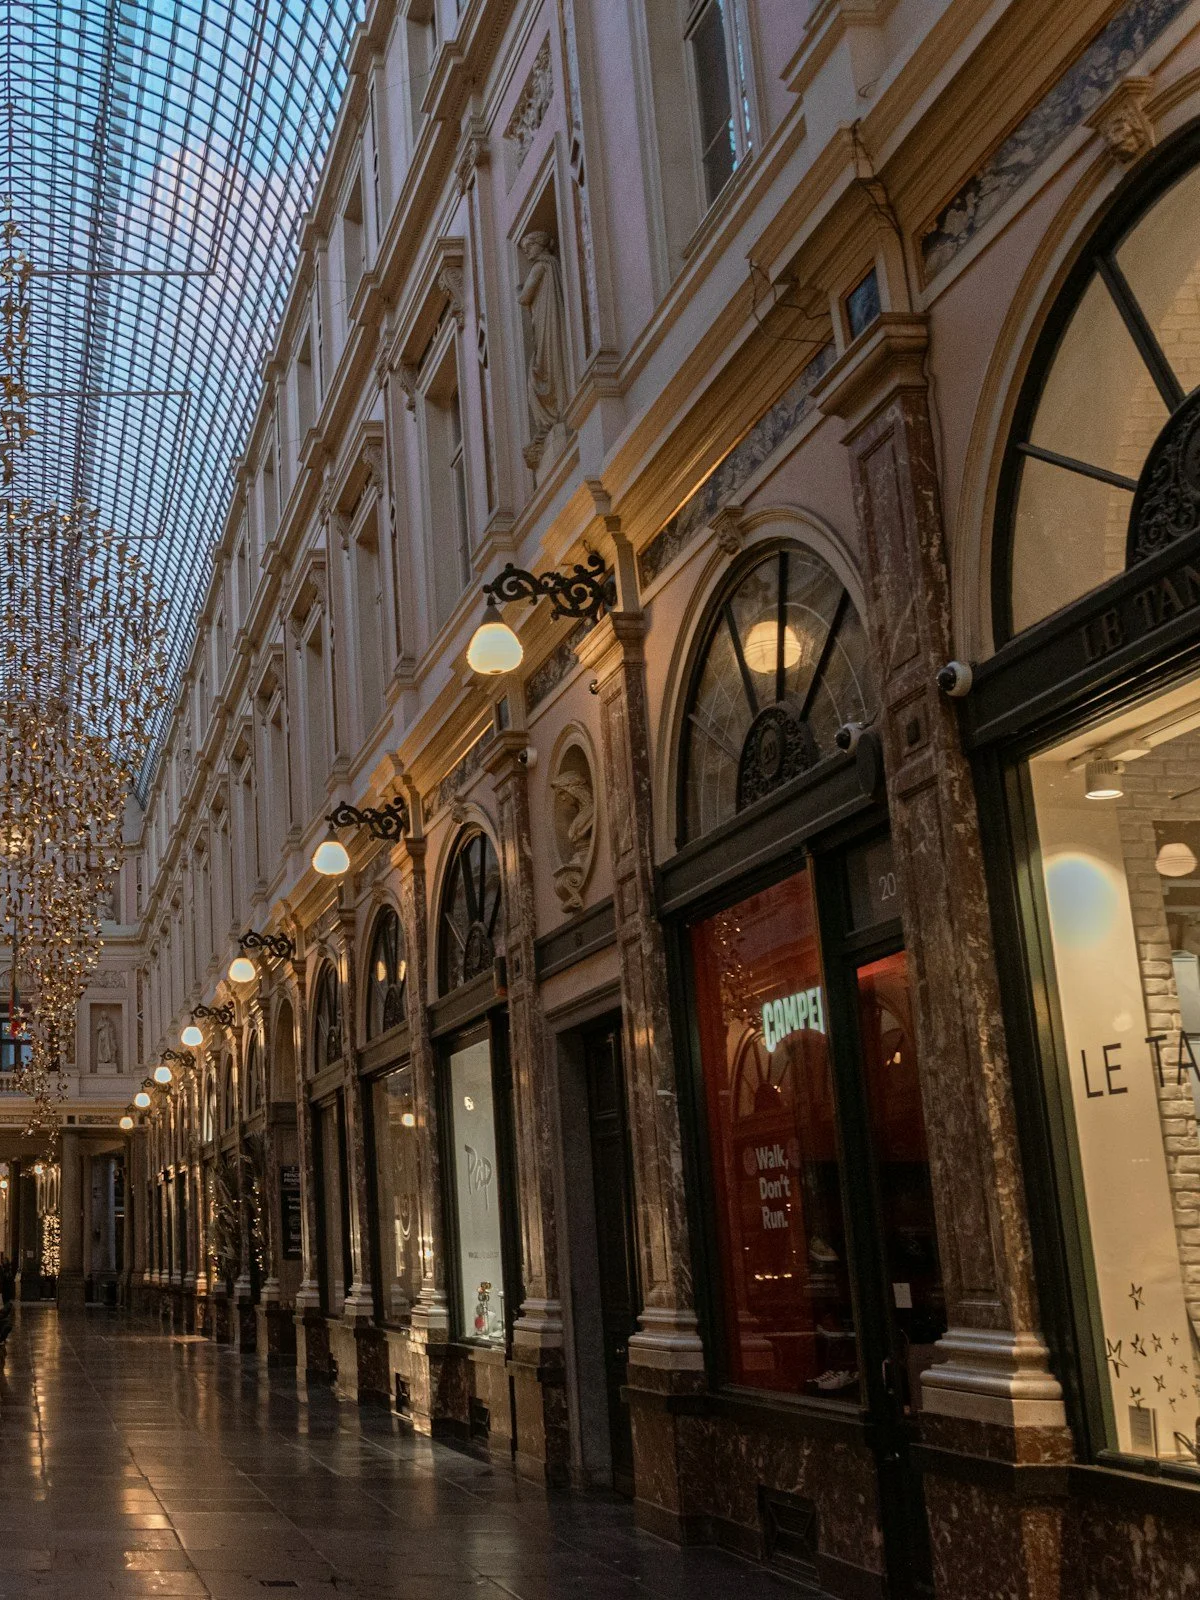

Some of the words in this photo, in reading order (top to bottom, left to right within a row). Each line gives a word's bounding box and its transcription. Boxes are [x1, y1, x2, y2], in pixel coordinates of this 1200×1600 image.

[1080, 607, 1124, 660] LE
[879, 872, 897, 901] 20
[1081, 1042, 1128, 1099] LE
[1144, 1030, 1200, 1088] TA
[755, 1144, 789, 1170] Walk,
[760, 1174, 791, 1199] Don't
[762, 1206, 788, 1229] Run.
